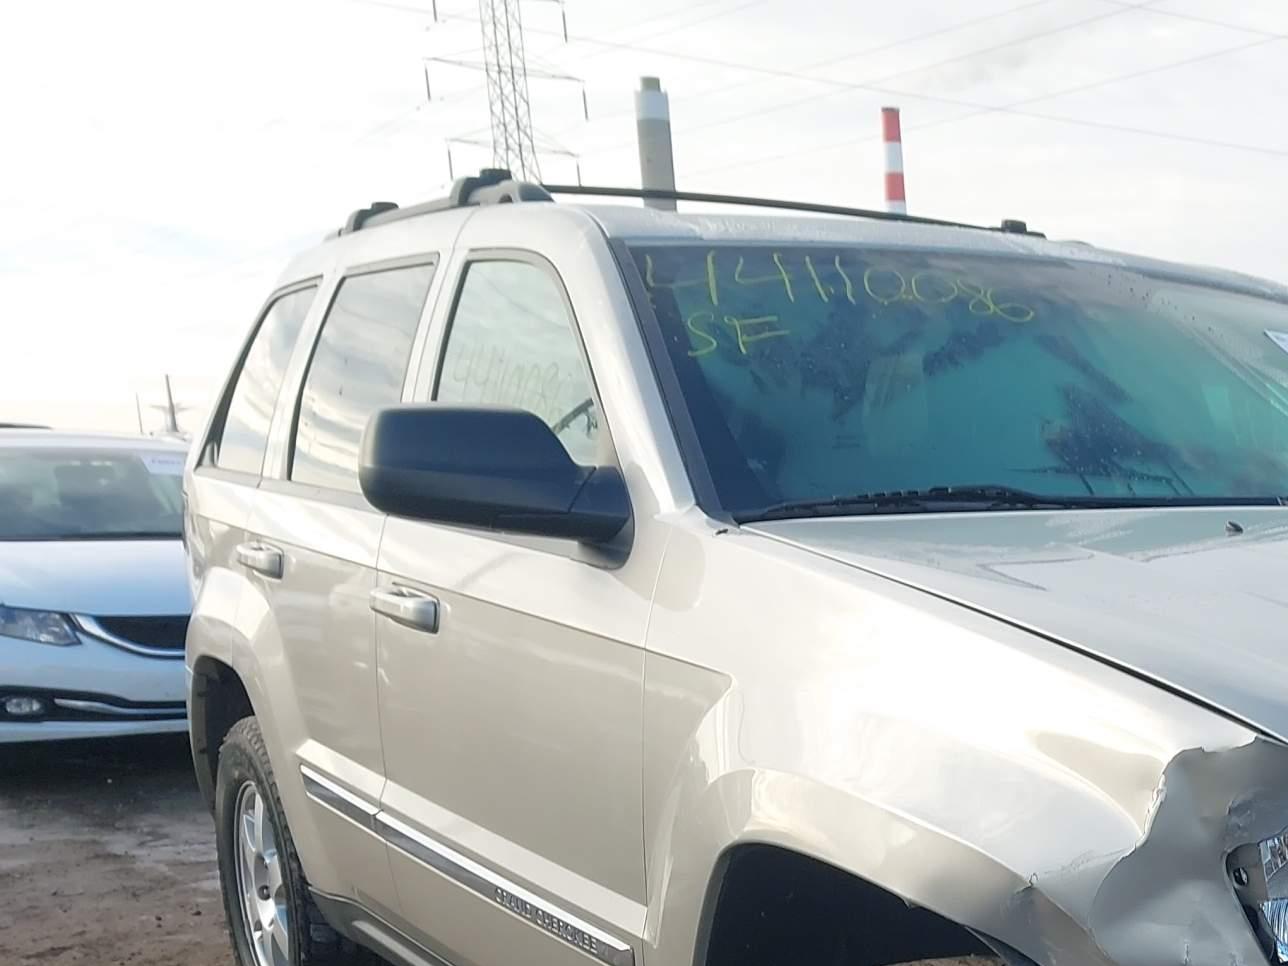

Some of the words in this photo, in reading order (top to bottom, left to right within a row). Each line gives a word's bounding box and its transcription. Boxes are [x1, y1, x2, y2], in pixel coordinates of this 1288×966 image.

[687, 312, 790, 357] SF
[494, 887, 532, 919] GRAND
[534, 909, 599, 954] CHEROKEE
